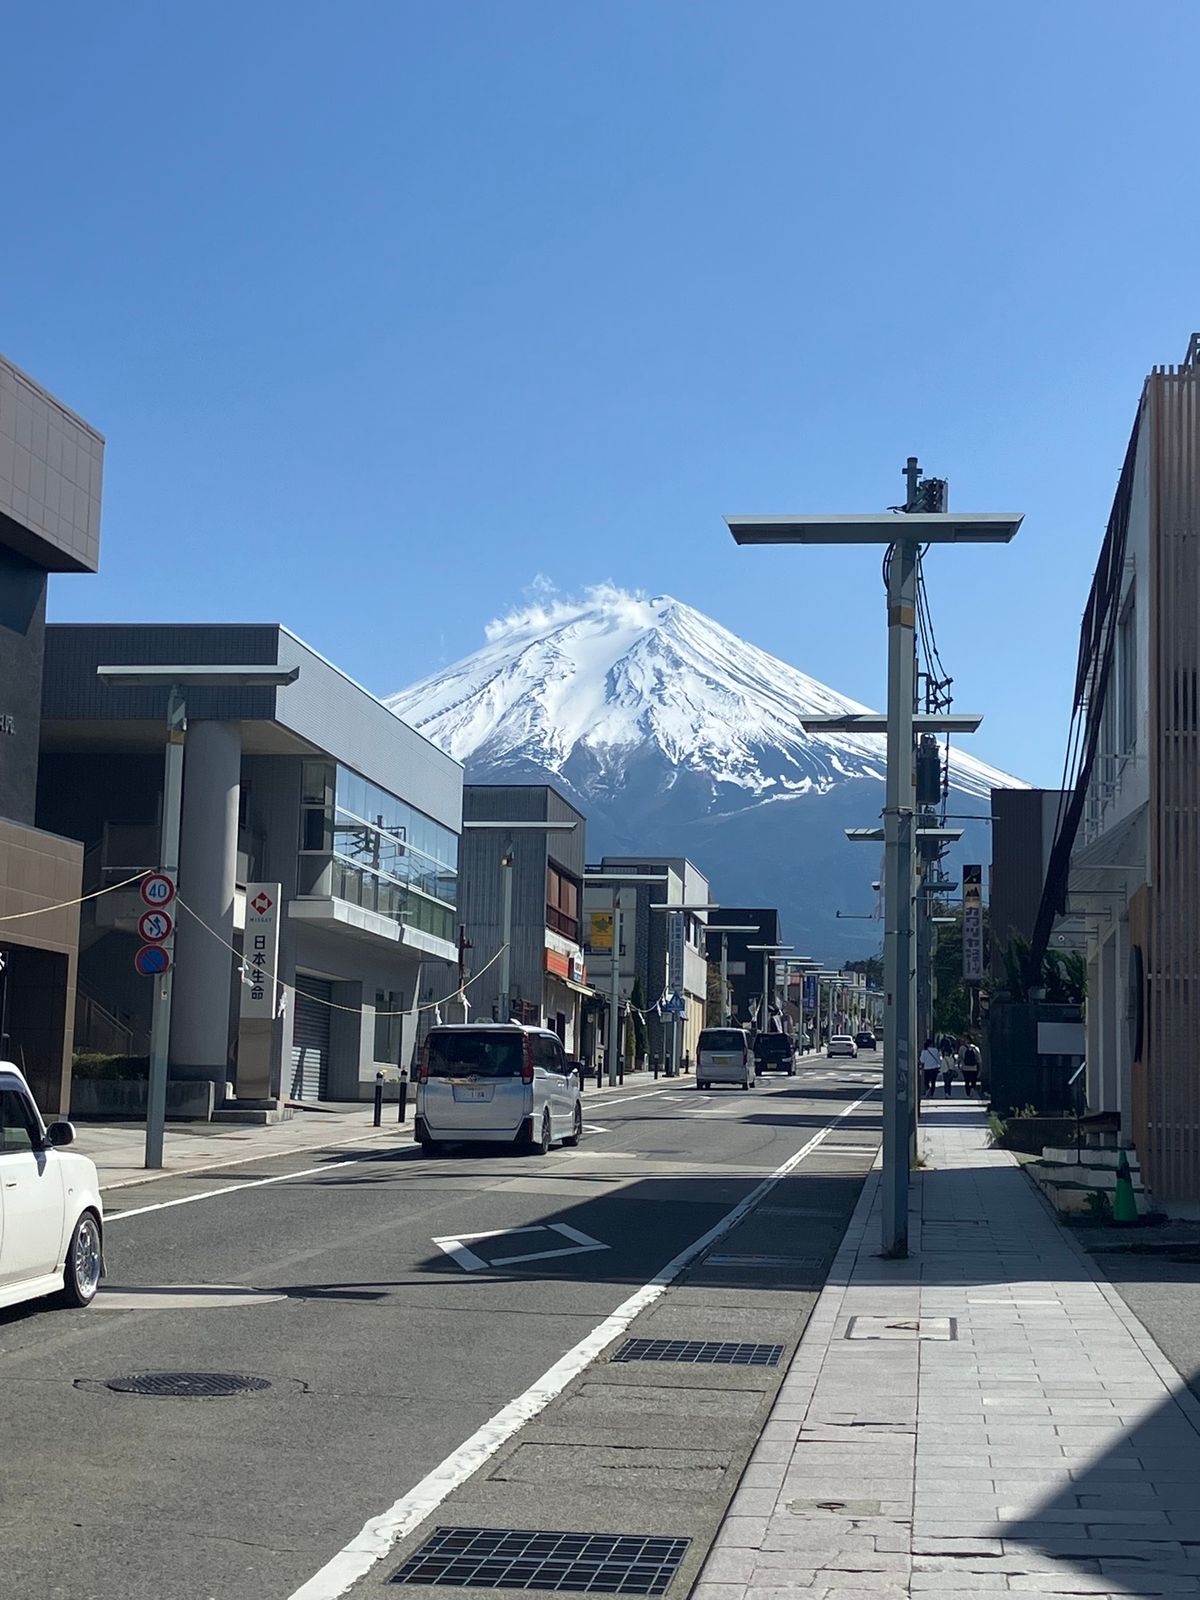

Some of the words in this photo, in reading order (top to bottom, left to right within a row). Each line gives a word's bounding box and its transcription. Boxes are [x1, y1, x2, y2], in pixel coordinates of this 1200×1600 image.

[148, 884, 167, 898] 40
[250, 935, 266, 1000] 日本生命
